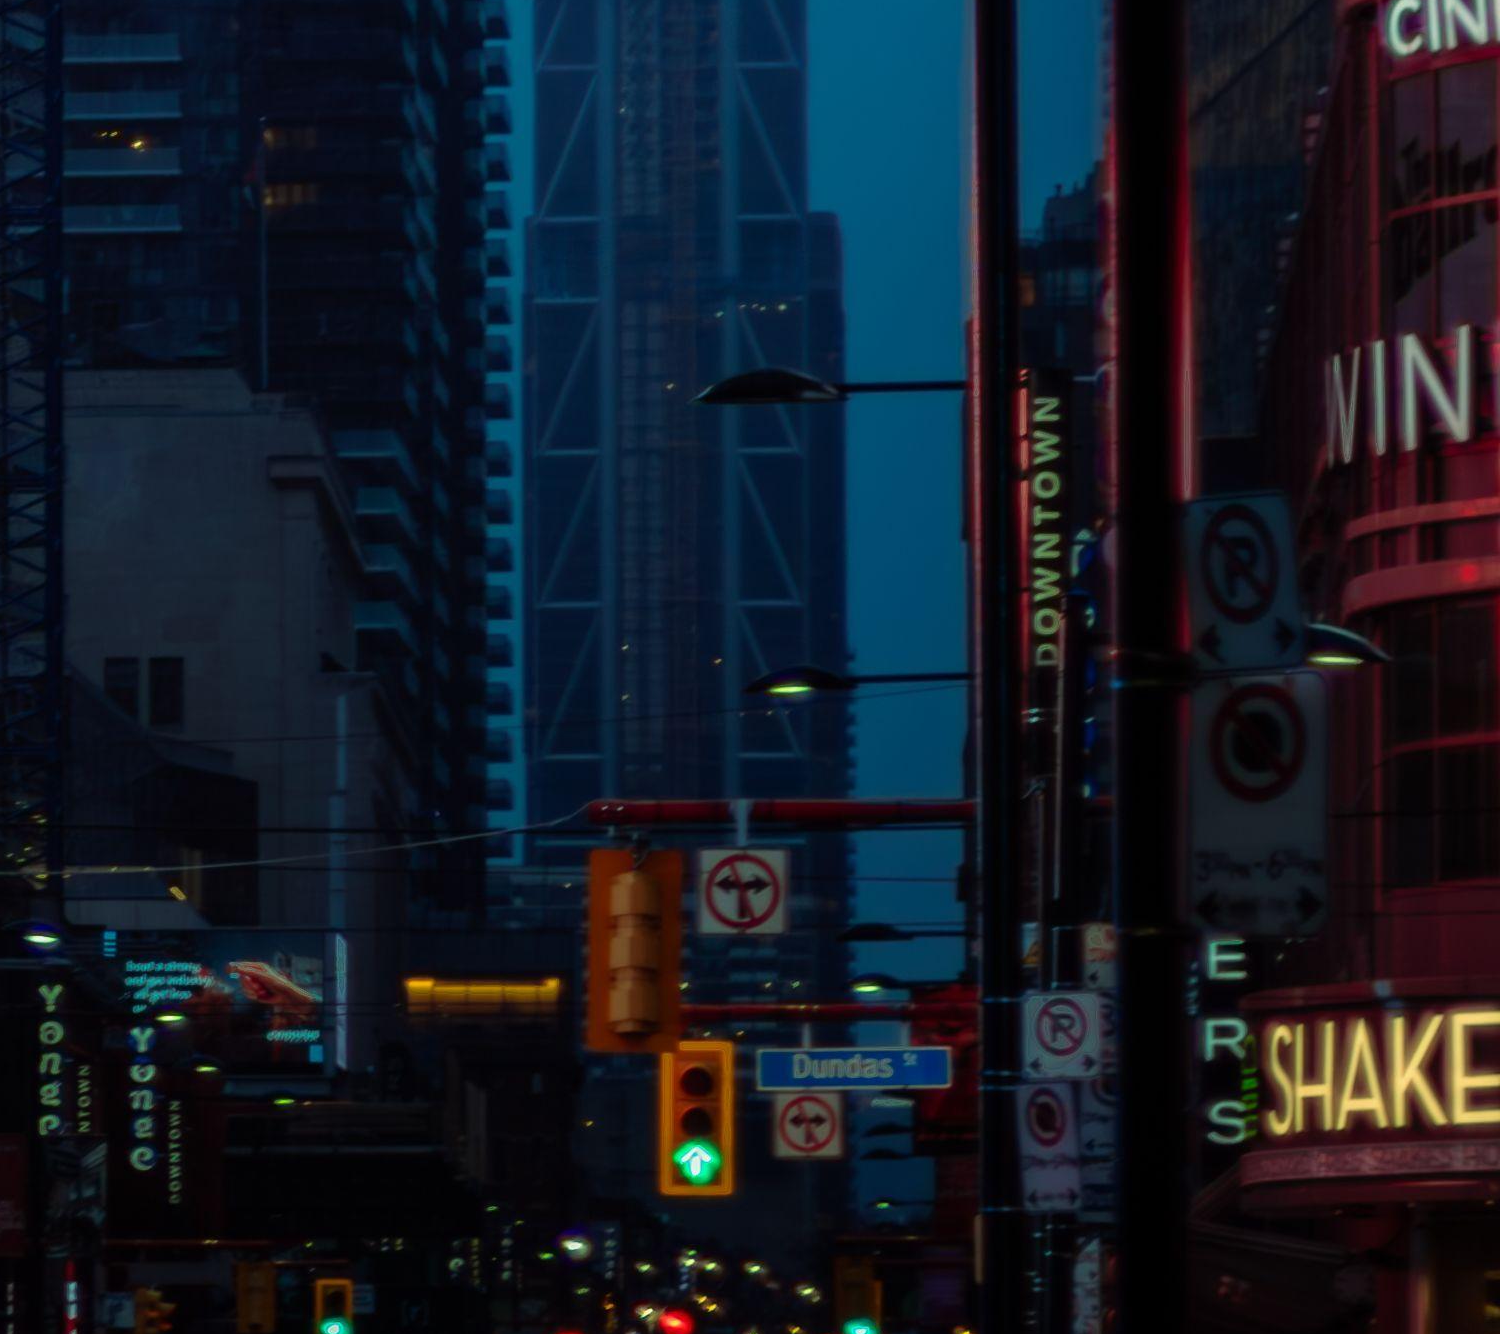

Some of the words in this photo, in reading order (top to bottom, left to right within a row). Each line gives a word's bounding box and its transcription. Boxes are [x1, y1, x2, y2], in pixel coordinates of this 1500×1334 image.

[1032, 394, 1064, 667] DOWNTOWN
[128, 1026, 158, 1172] Yonge
[791, 1053, 895, 1080] Dundas
[1266, 1008, 1500, 1138] SHAKE
[168, 1099, 183, 1205] DOWNTOWN
